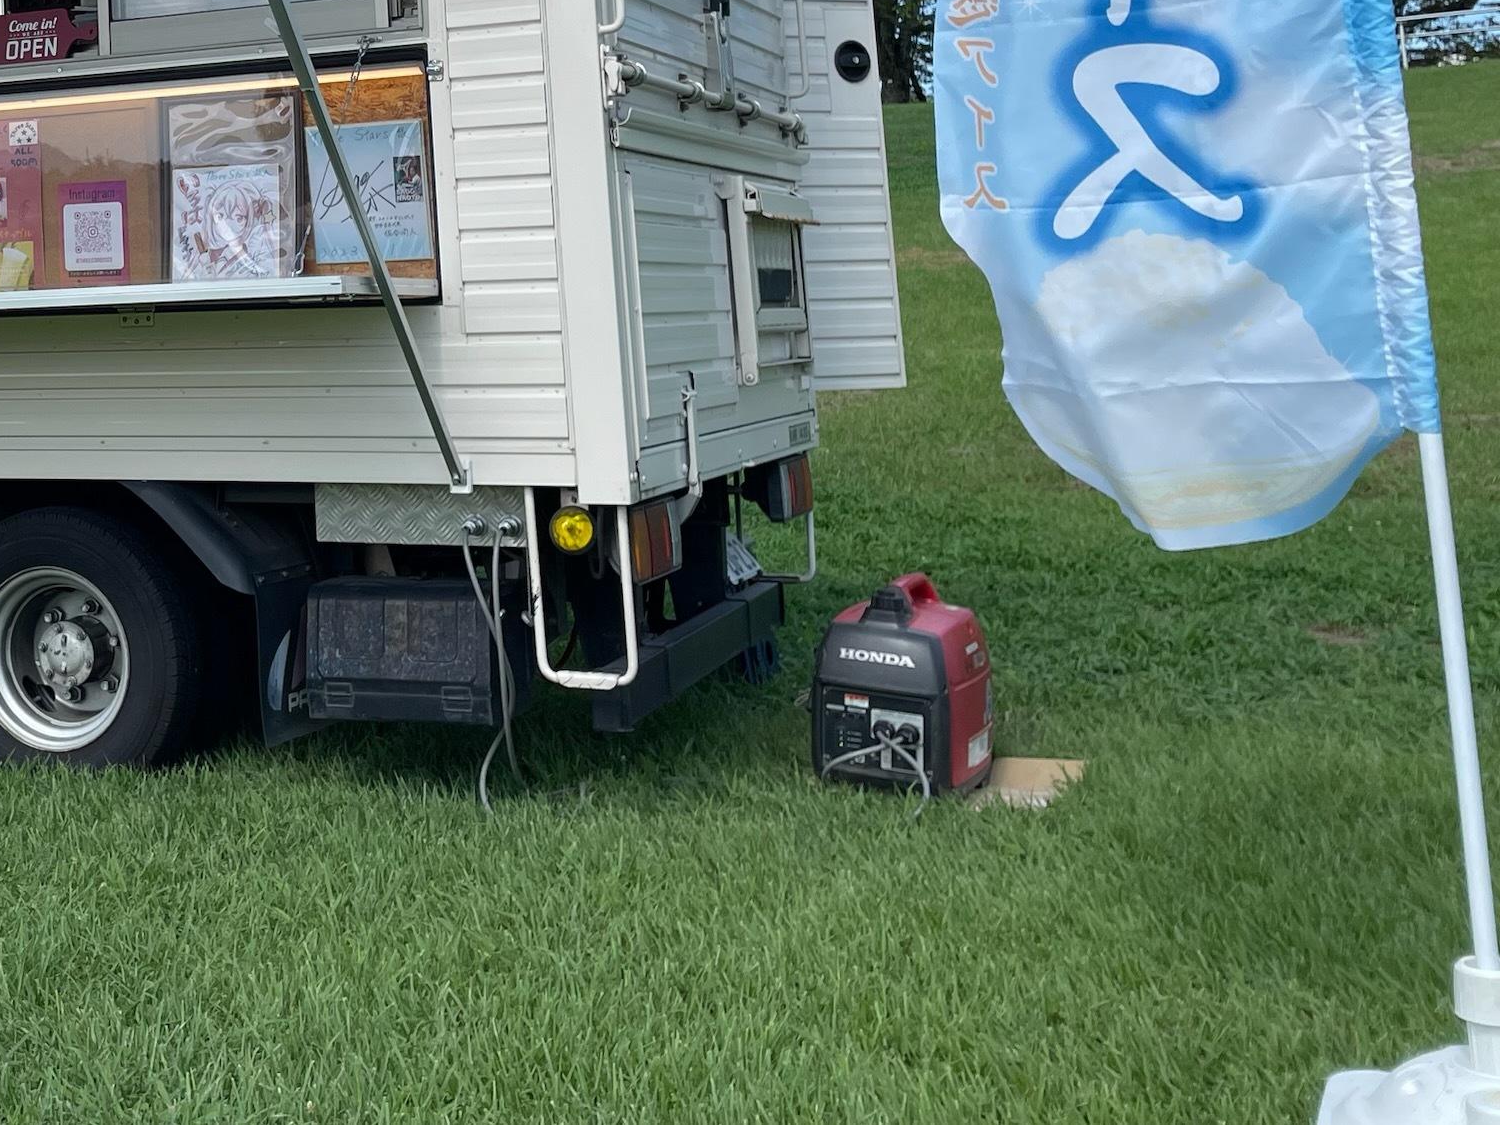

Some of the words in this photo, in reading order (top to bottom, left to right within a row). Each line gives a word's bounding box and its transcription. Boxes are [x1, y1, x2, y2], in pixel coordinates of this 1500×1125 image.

[8, 20, 38, 33] Come
[40, 17, 58, 30] in!
[5, 37, 58, 60] OPEN
[10, 123, 24, 138] Three
[25, 122, 37, 137] Stars
[14, 147, 33, 155] ALL
[839, 647, 916, 669] HONDA
